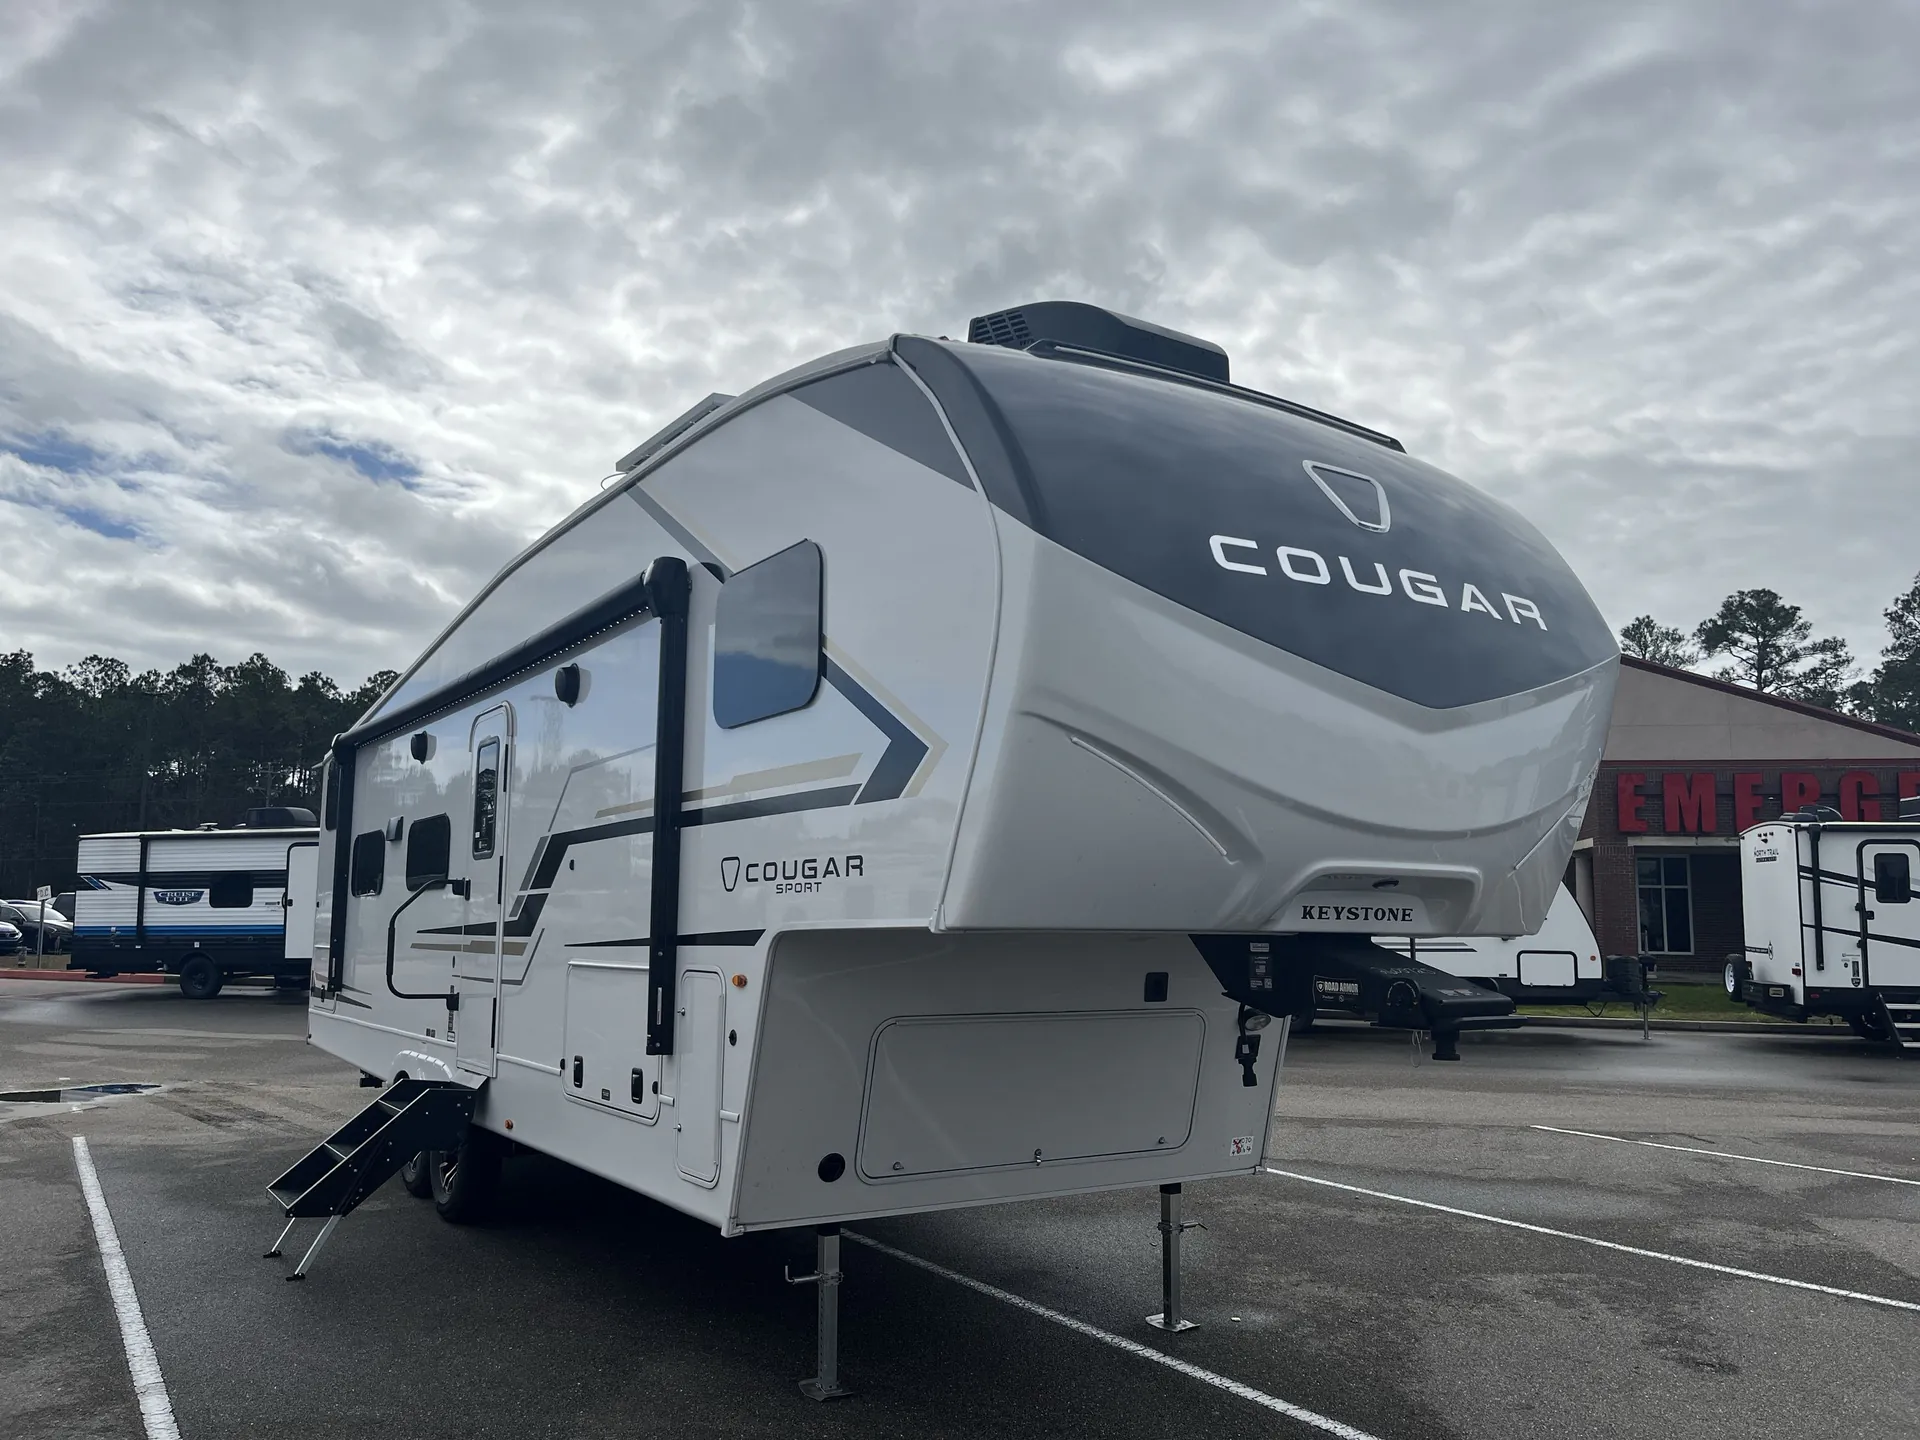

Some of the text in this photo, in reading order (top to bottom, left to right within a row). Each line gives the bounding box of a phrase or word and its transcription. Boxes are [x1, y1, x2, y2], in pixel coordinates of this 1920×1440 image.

[1209, 534, 1548, 632] COUGAR
[746, 855, 864, 882] COUGAR
[776, 882, 822, 894] SPORT
[1301, 905, 1414, 922] KEYSTONE
[1324, 981, 1359, 993] ROAD ARMOR
